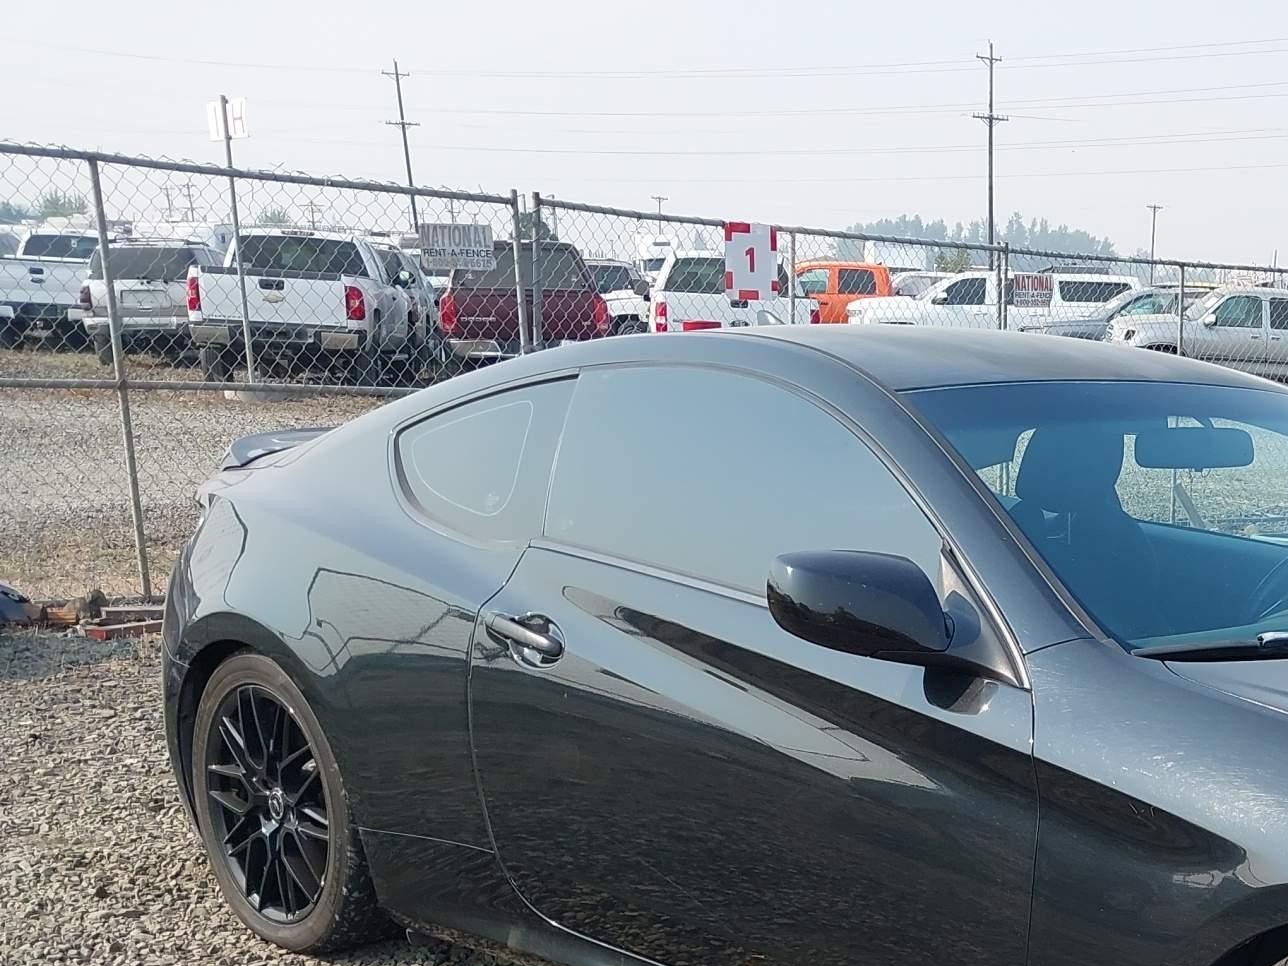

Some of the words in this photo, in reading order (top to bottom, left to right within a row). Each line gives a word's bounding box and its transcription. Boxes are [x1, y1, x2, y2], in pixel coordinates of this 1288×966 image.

[231, 103, 245, 135] H
[421, 225, 491, 248] NATIONAL
[745, 247, 755, 273] 1
[1015, 275, 1053, 291] NATIONAL
